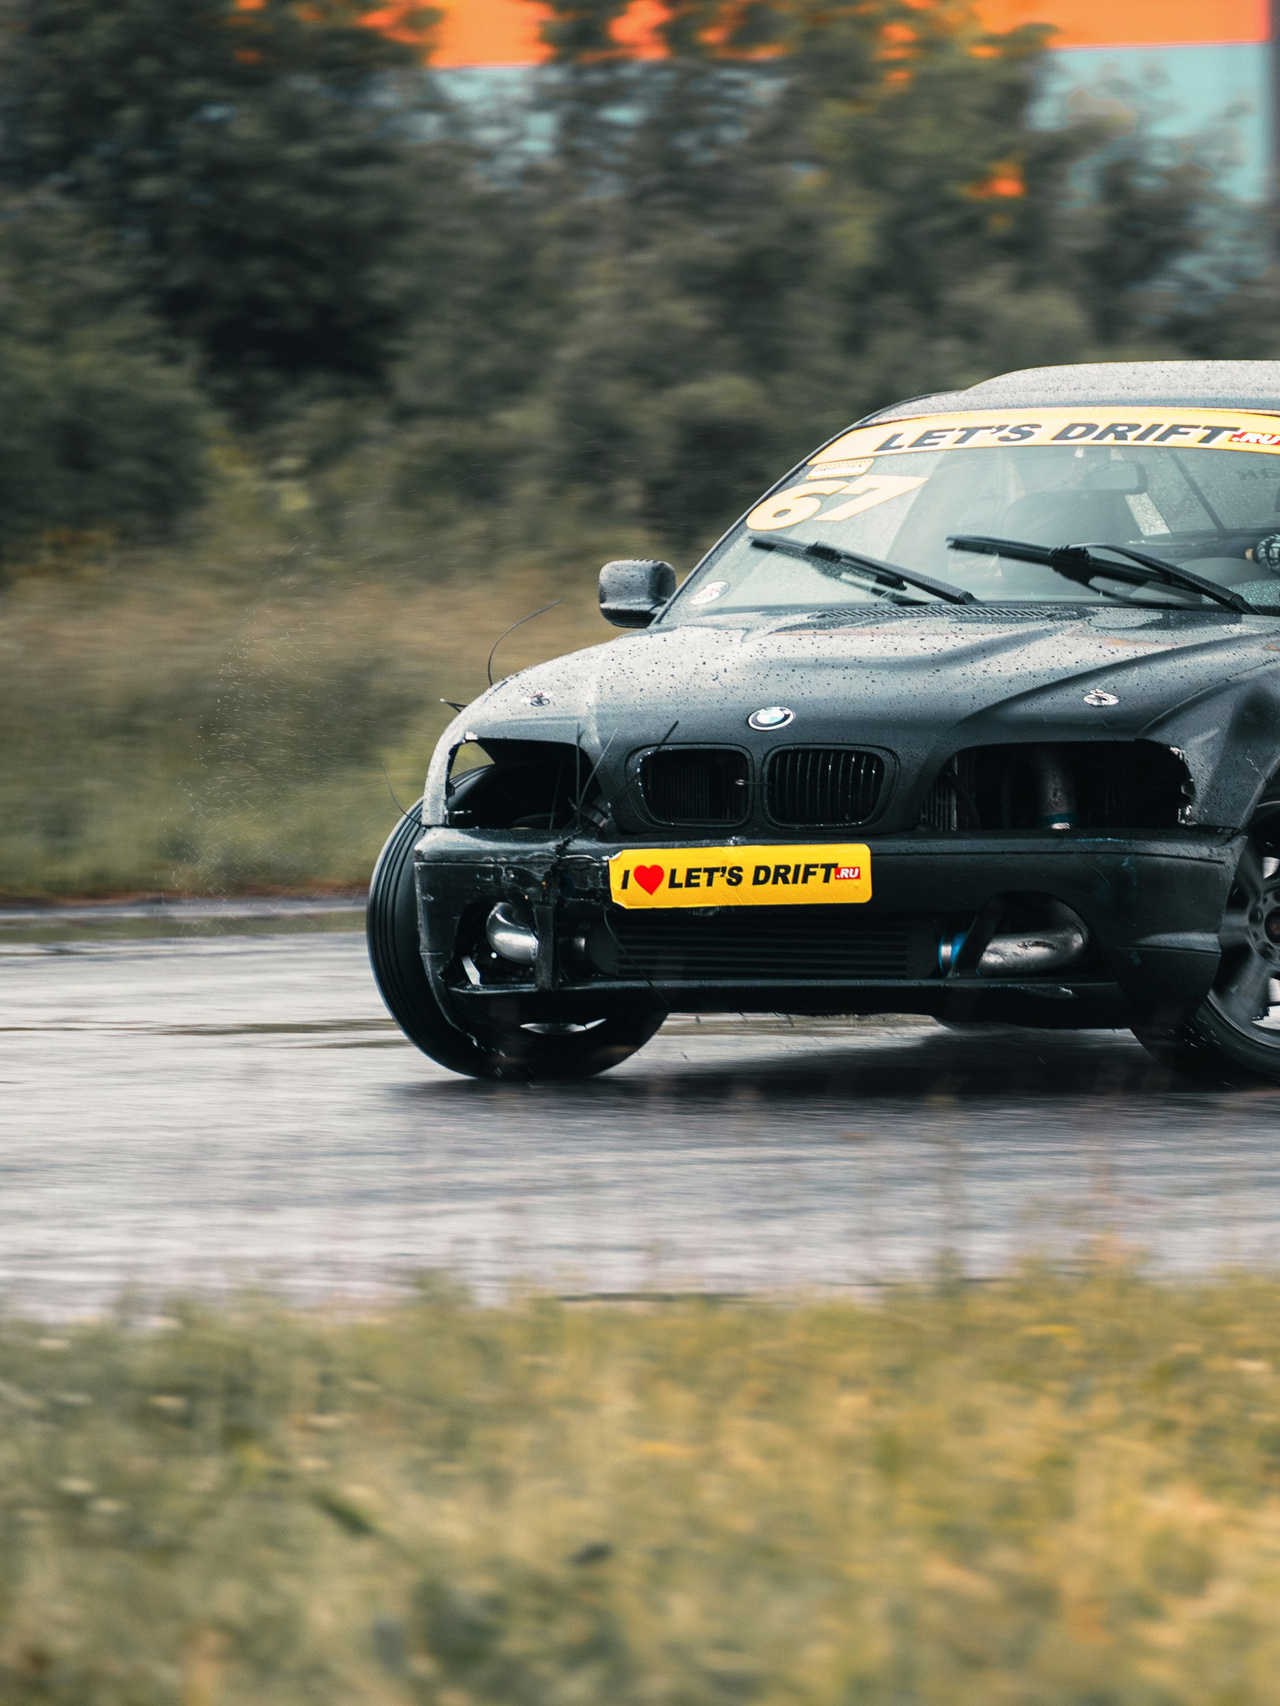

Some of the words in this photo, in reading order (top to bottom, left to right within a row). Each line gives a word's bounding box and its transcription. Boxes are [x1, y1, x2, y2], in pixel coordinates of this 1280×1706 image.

[873, 422, 1042, 452] LET'S
[745, 474, 929, 532] 67
[620, 869, 630, 889] I
[668, 866, 743, 889] LET'S
